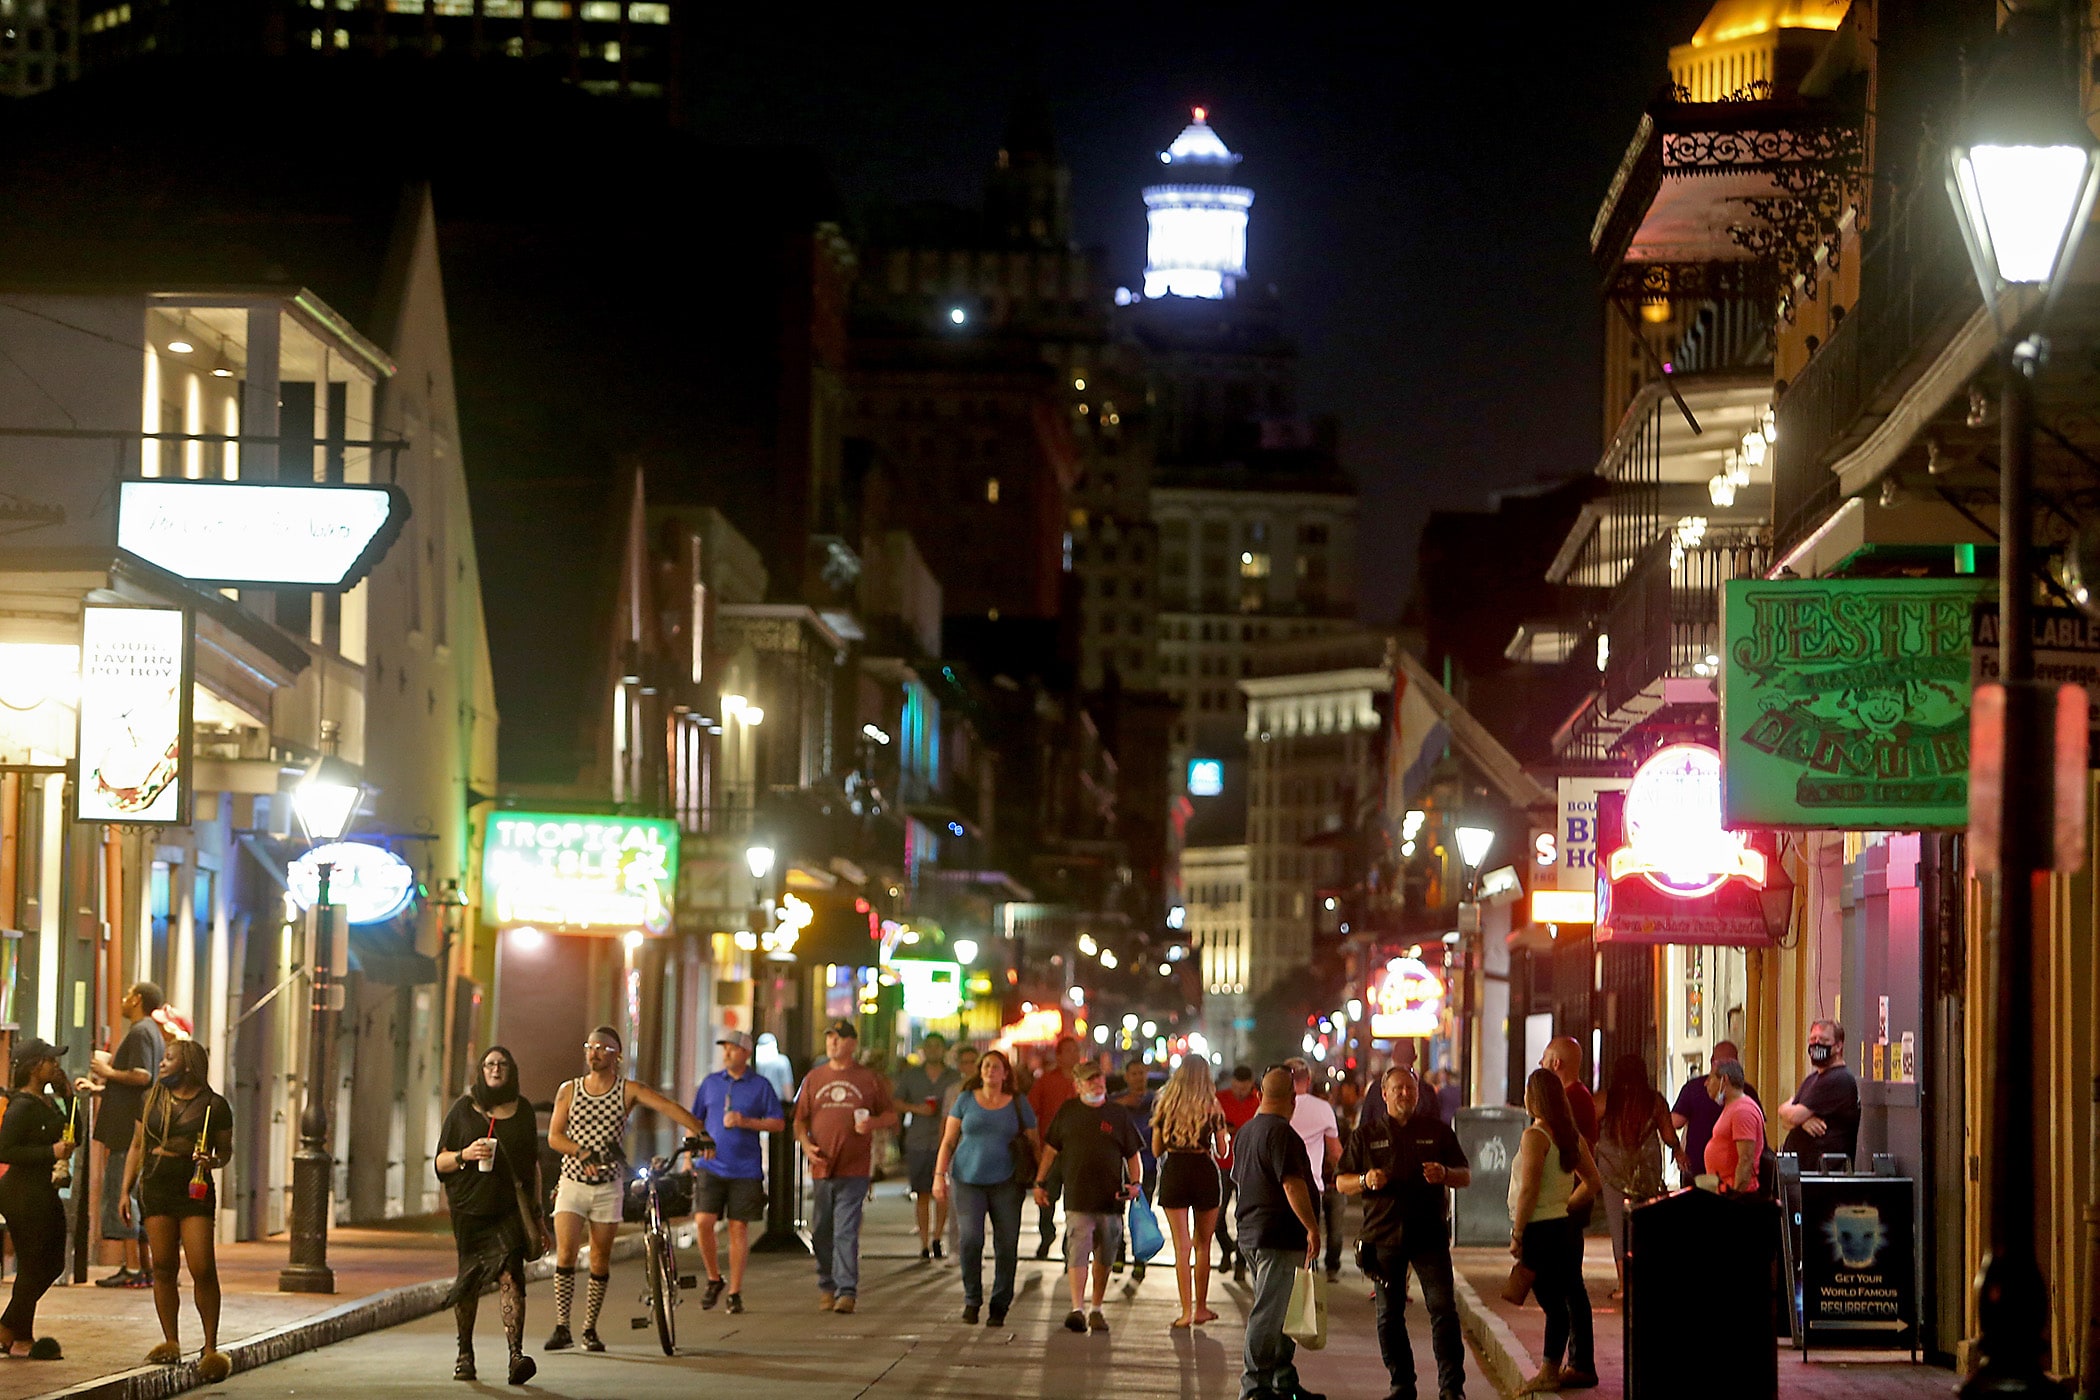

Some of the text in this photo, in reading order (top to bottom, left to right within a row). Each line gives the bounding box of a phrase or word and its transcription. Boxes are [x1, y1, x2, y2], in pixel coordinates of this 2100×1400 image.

[1979, 613, 2100, 647] ALABLE
[497, 821, 660, 852] TROPICAL
[1835, 1274, 1882, 1284] GET YOUR
[1820, 1287, 1898, 1298] WORLD FAMOUS
[1820, 1301, 1898, 1315] RESURRECTION
